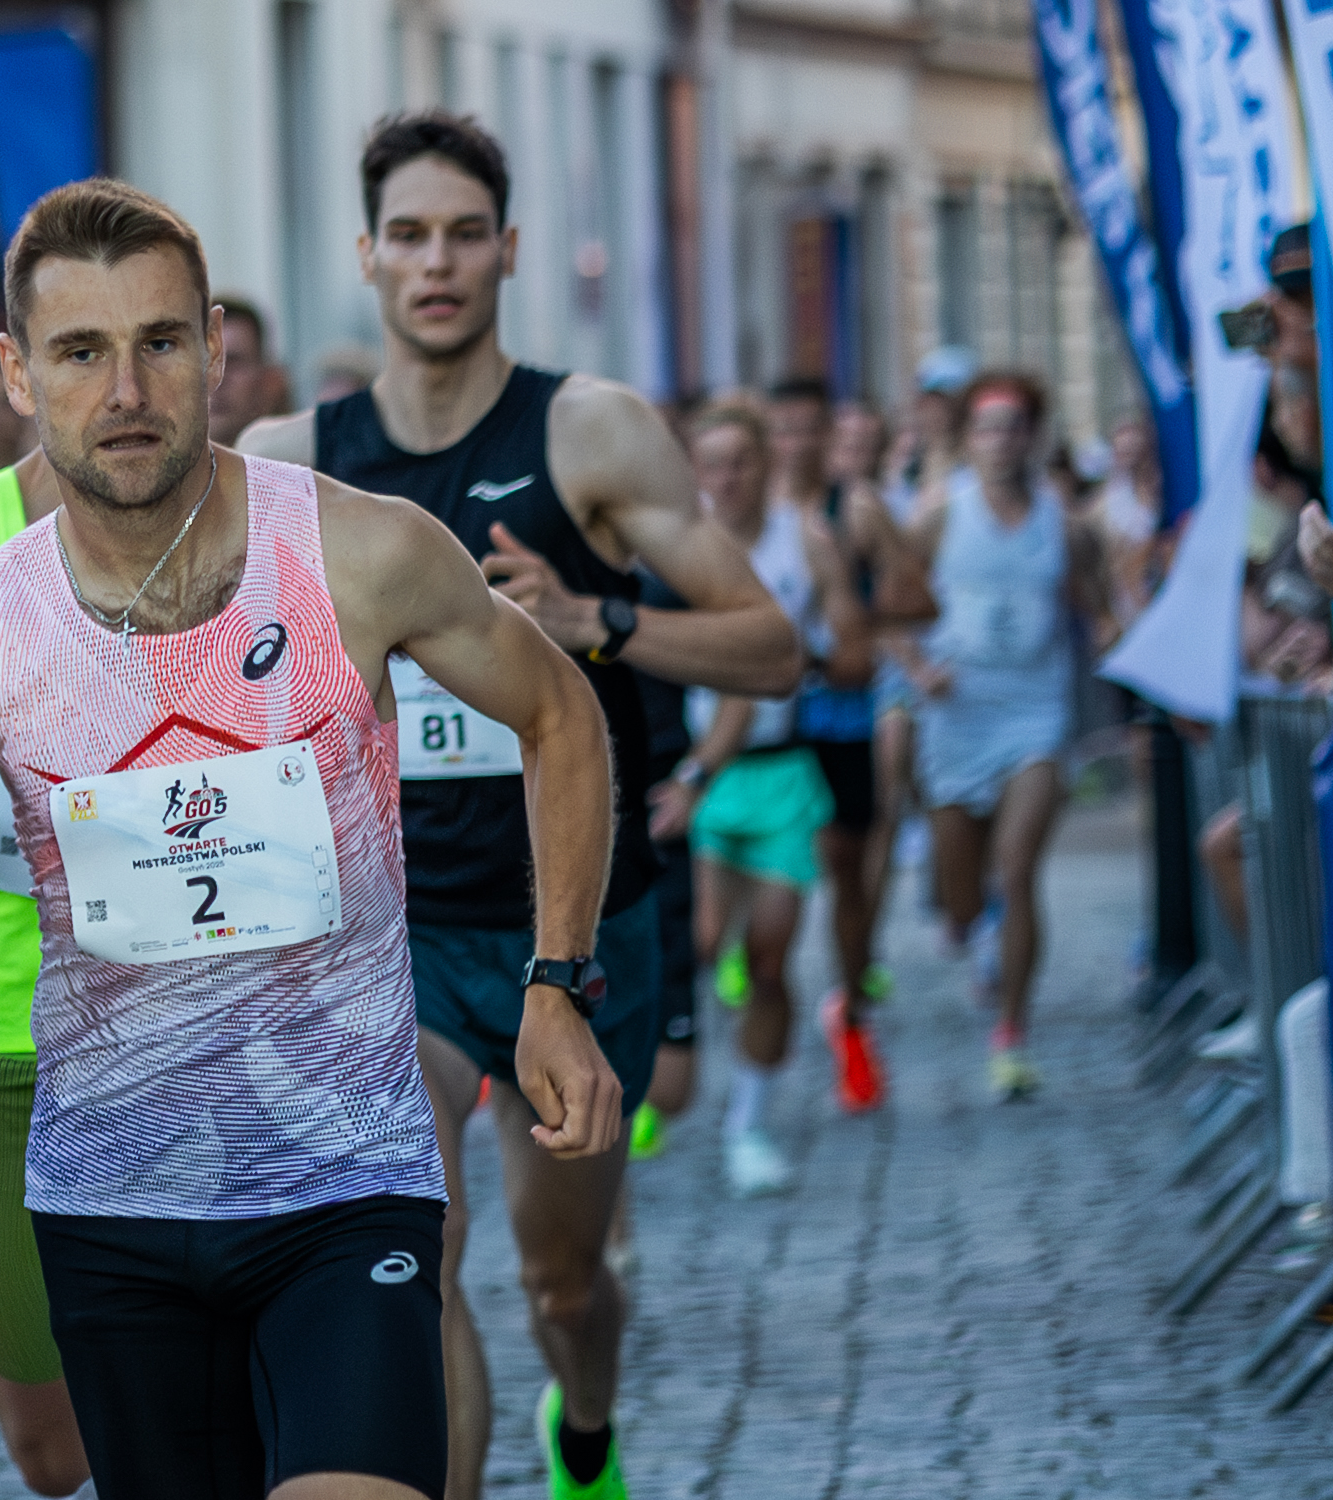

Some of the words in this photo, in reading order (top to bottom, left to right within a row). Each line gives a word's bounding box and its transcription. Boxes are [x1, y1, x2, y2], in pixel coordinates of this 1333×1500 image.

[422, 714, 465, 750] 81
[133, 850, 219, 870] MISTRZOSTWA
[222, 842, 265, 857] POLSKI
[169, 837, 227, 854] OTWARTE
[186, 875, 225, 925] 2
